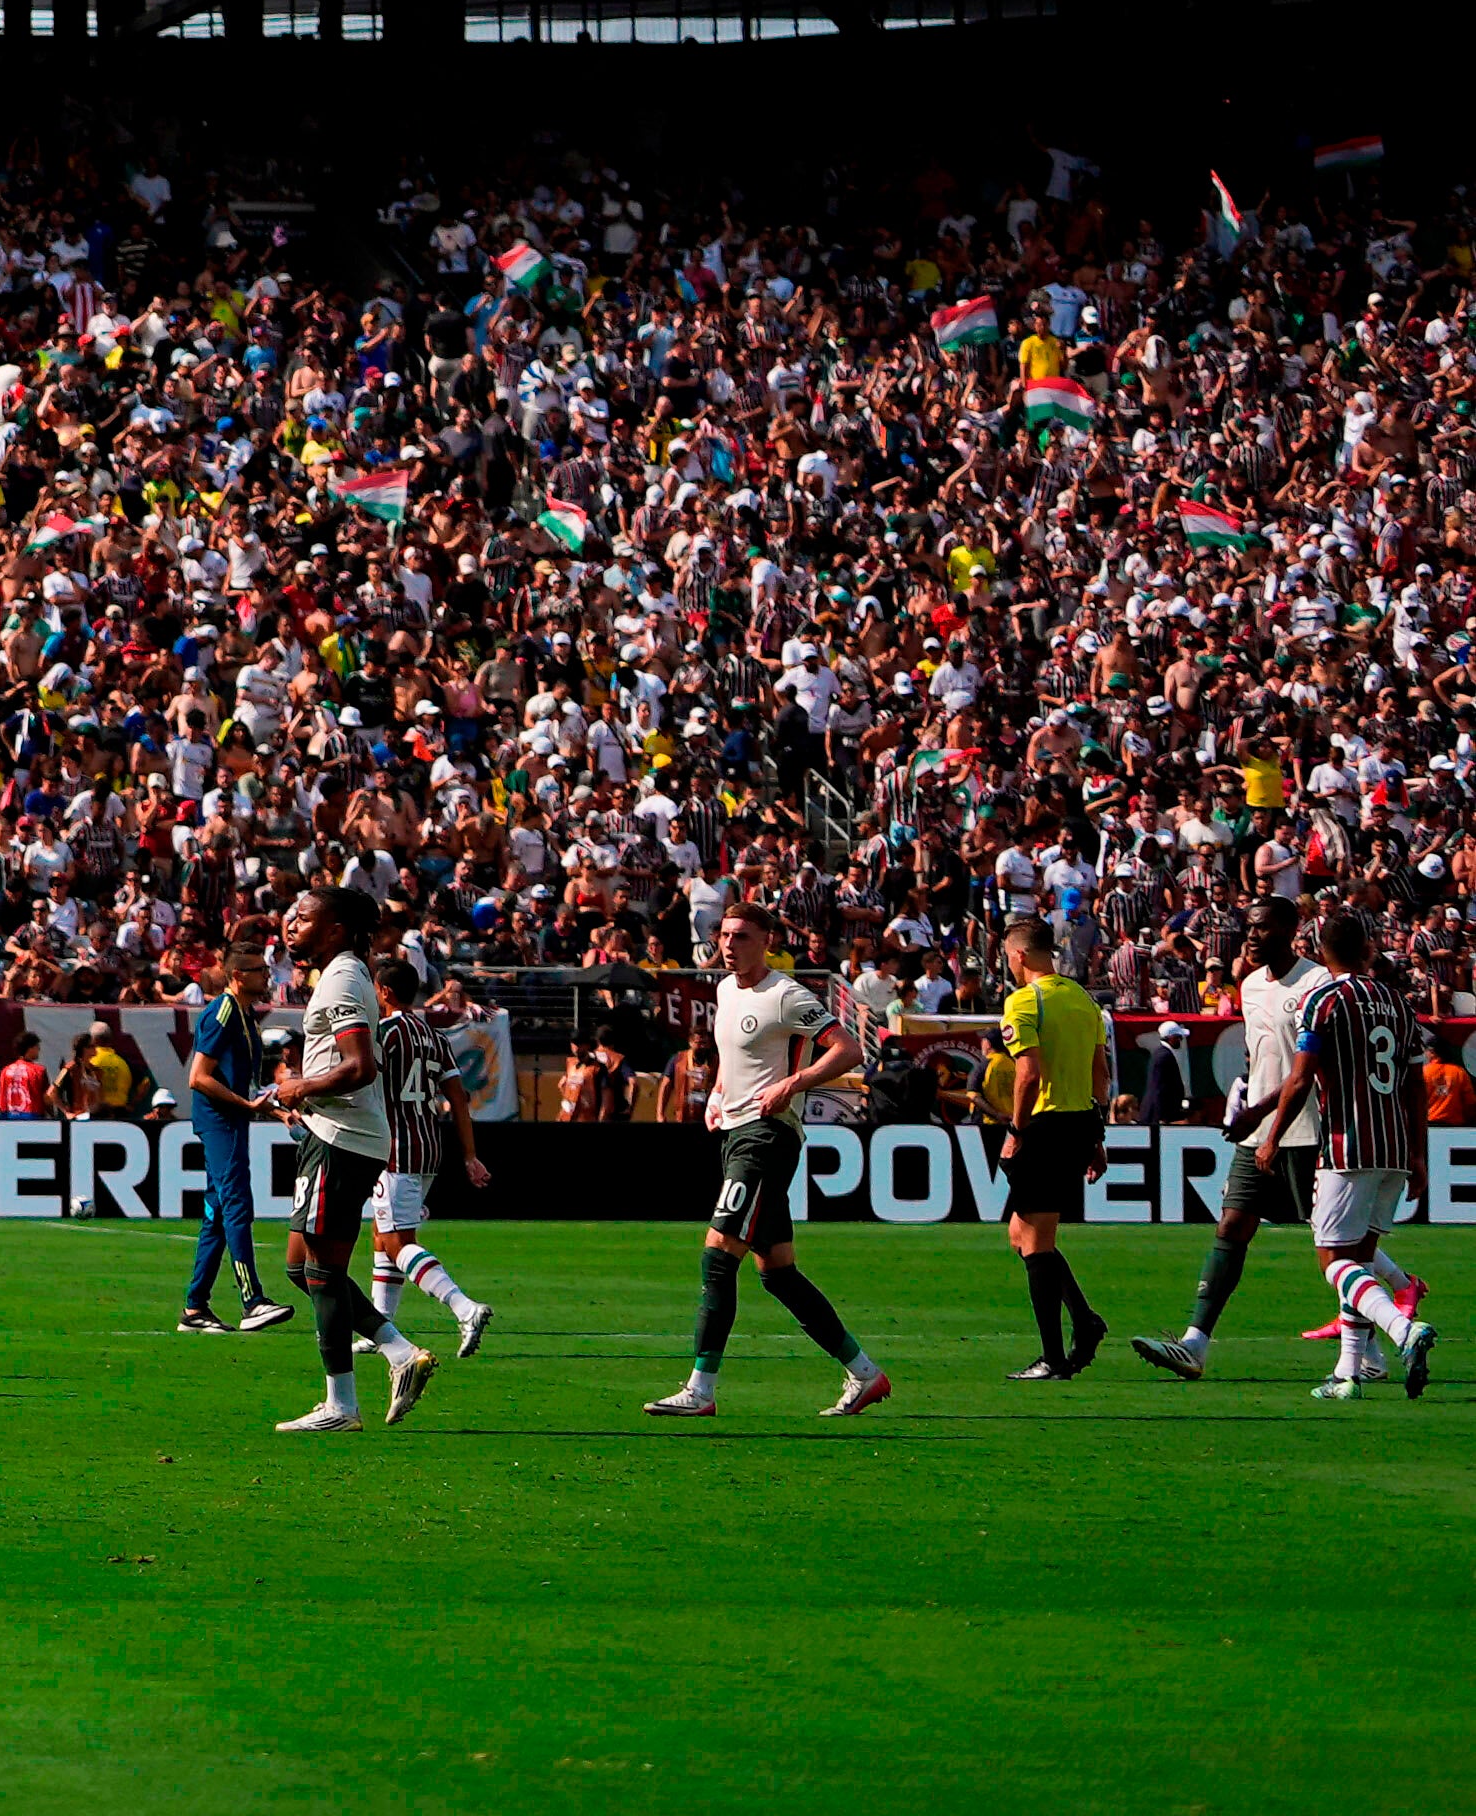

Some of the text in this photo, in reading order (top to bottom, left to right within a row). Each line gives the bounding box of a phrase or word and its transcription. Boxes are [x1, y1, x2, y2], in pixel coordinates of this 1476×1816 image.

[1356, 1001, 1399, 1018] T.SILVA
[1368, 1025, 1396, 1095] 3
[717, 1178, 747, 1213] 10
[802, 1124, 1476, 1224] POERE
